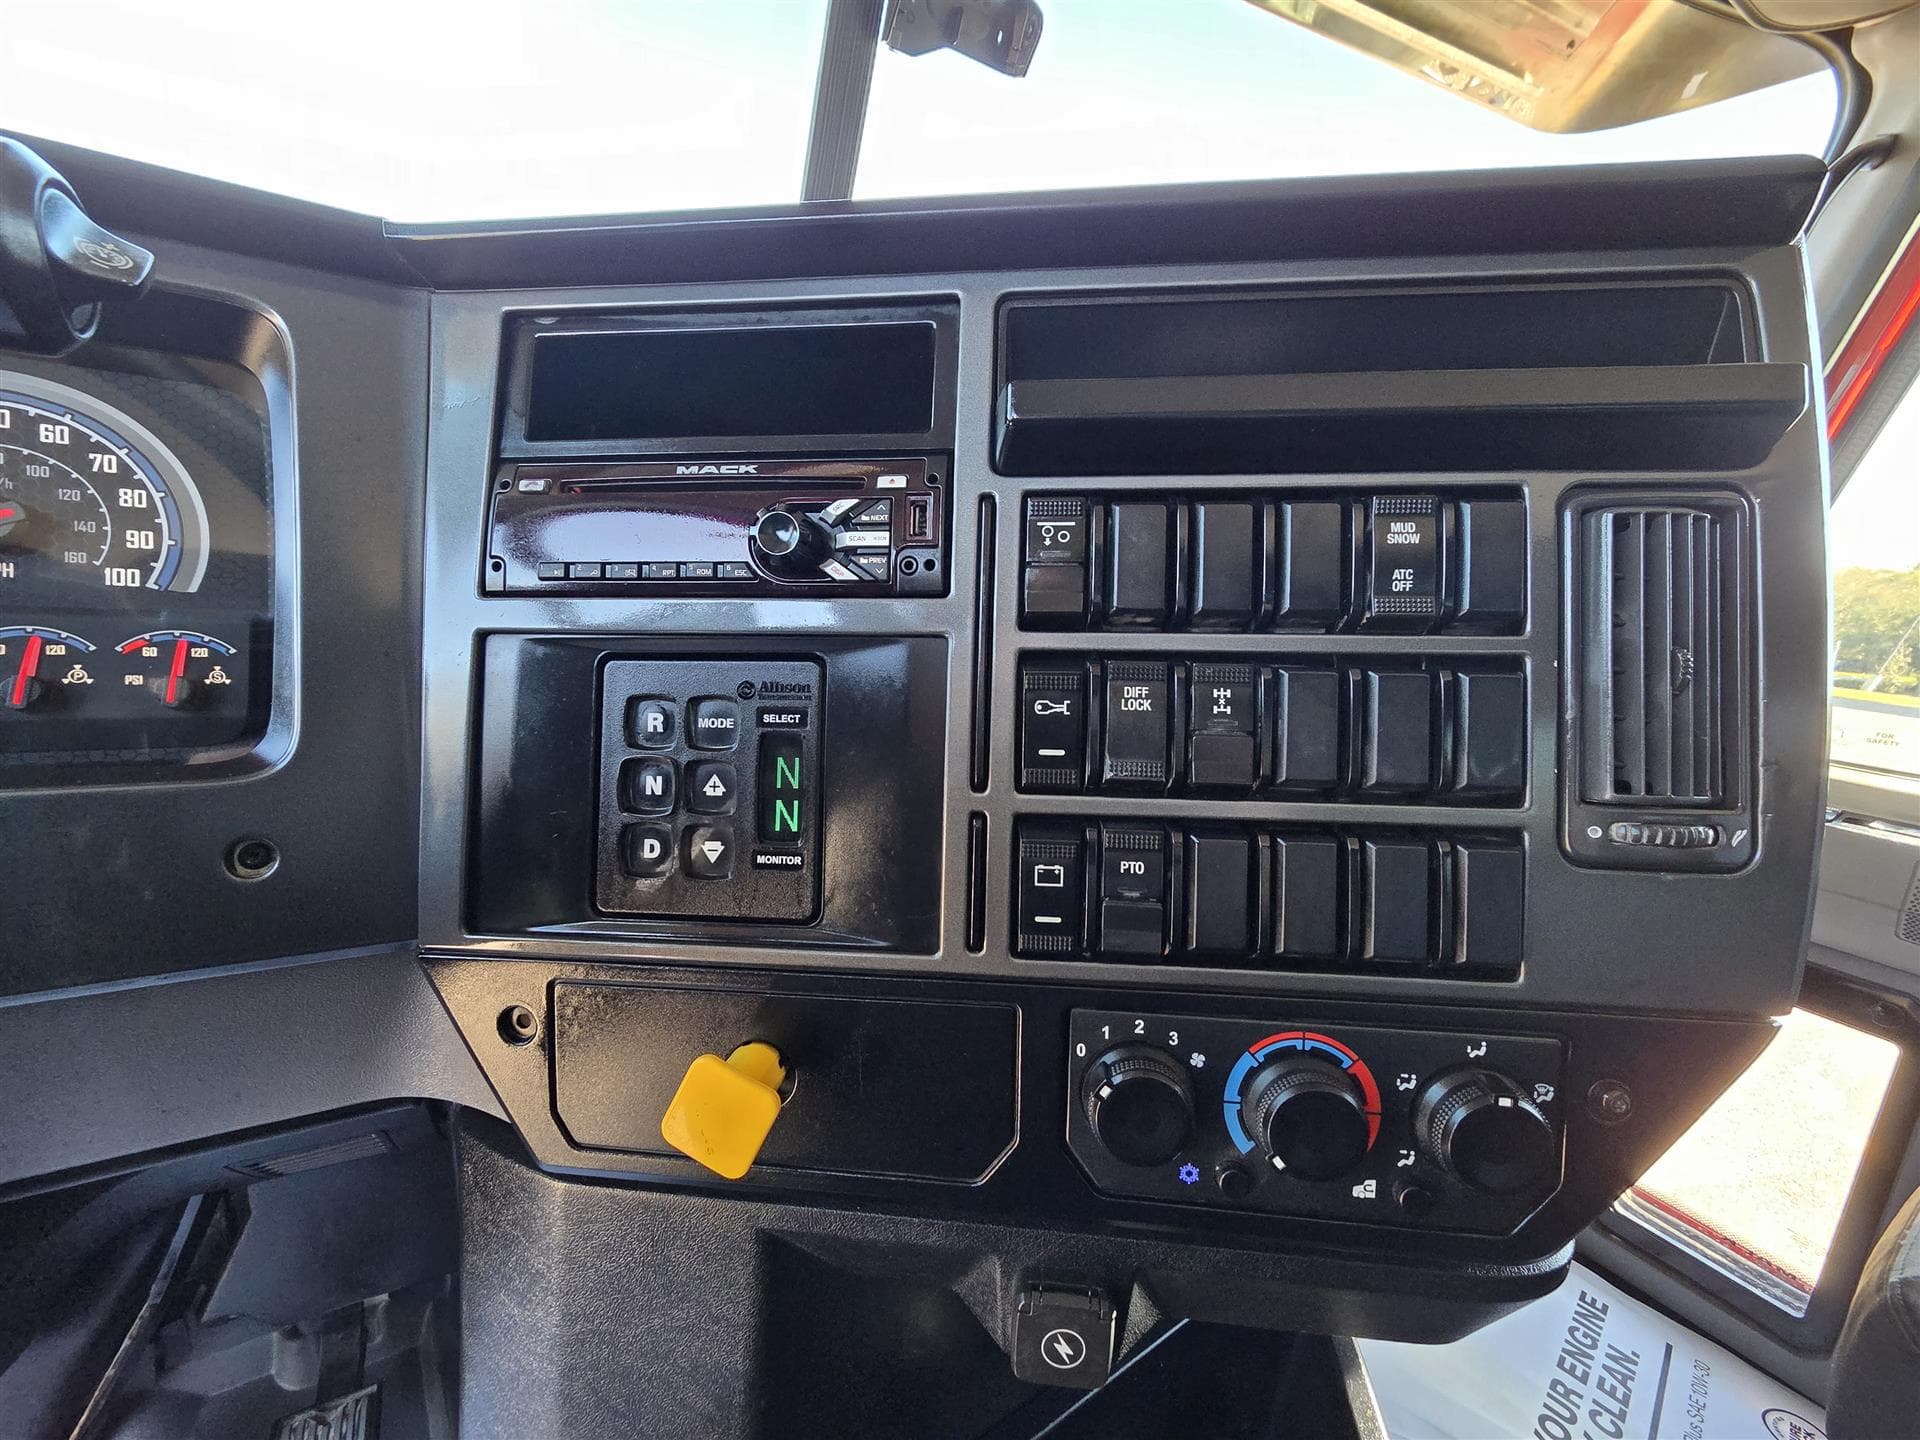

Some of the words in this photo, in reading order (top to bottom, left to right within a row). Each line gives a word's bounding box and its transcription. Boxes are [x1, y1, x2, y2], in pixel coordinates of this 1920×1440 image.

[39, 424, 70, 445] 60
[88, 452, 118, 474] 70
[676, 464, 758, 475] MACK
[26, 465, 50, 478] 100
[58, 488, 81, 502] 120
[118, 488, 147, 508] 80
[74, 521, 96, 533] 140
[1390, 522, 1416, 534] MUD
[125, 530, 154, 550] 90
[1386, 533, 1420, 545] SNOW
[64, 551, 87, 564] 160
[104, 567, 141, 587] 100
[734, 569, 749, 577] ESC
[1391, 568, 1414, 581] ATC
[1391, 580, 1413, 593] OFF
[45, 645, 66, 656] 120
[142, 647, 157, 657] 60
[191, 647, 209, 658] 120
[125, 675, 144, 686] PSI
[759, 681, 811, 694] Allison
[1123, 686, 1149, 699] DIFF
[1120, 698, 1152, 712] LOCK
[647, 713, 664, 733] R
[698, 717, 734, 729] MODE
[763, 714, 801, 723] SELECT
[1866, 737, 1900, 747] SAFETY
[776, 756, 800, 790] N
[645, 775, 663, 796] N
[774, 799, 799, 832] N
[643, 838, 661, 859] D
[756, 854, 802, 865] MONITOR
[1120, 861, 1145, 875] PTO
[1101, 1025, 1110, 1040] 1
[1134, 1019, 1145, 1034] 2
[1168, 1031, 1179, 1046] 3
[1076, 1043, 1086, 1057] 0
[1556, 1290, 1609, 1386] ENGINE
[1690, 1359, 1711, 1400] 10W-30
[1588, 1343, 1640, 1440] CLEAN.
[1687, 1394, 1706, 1424] SAE
